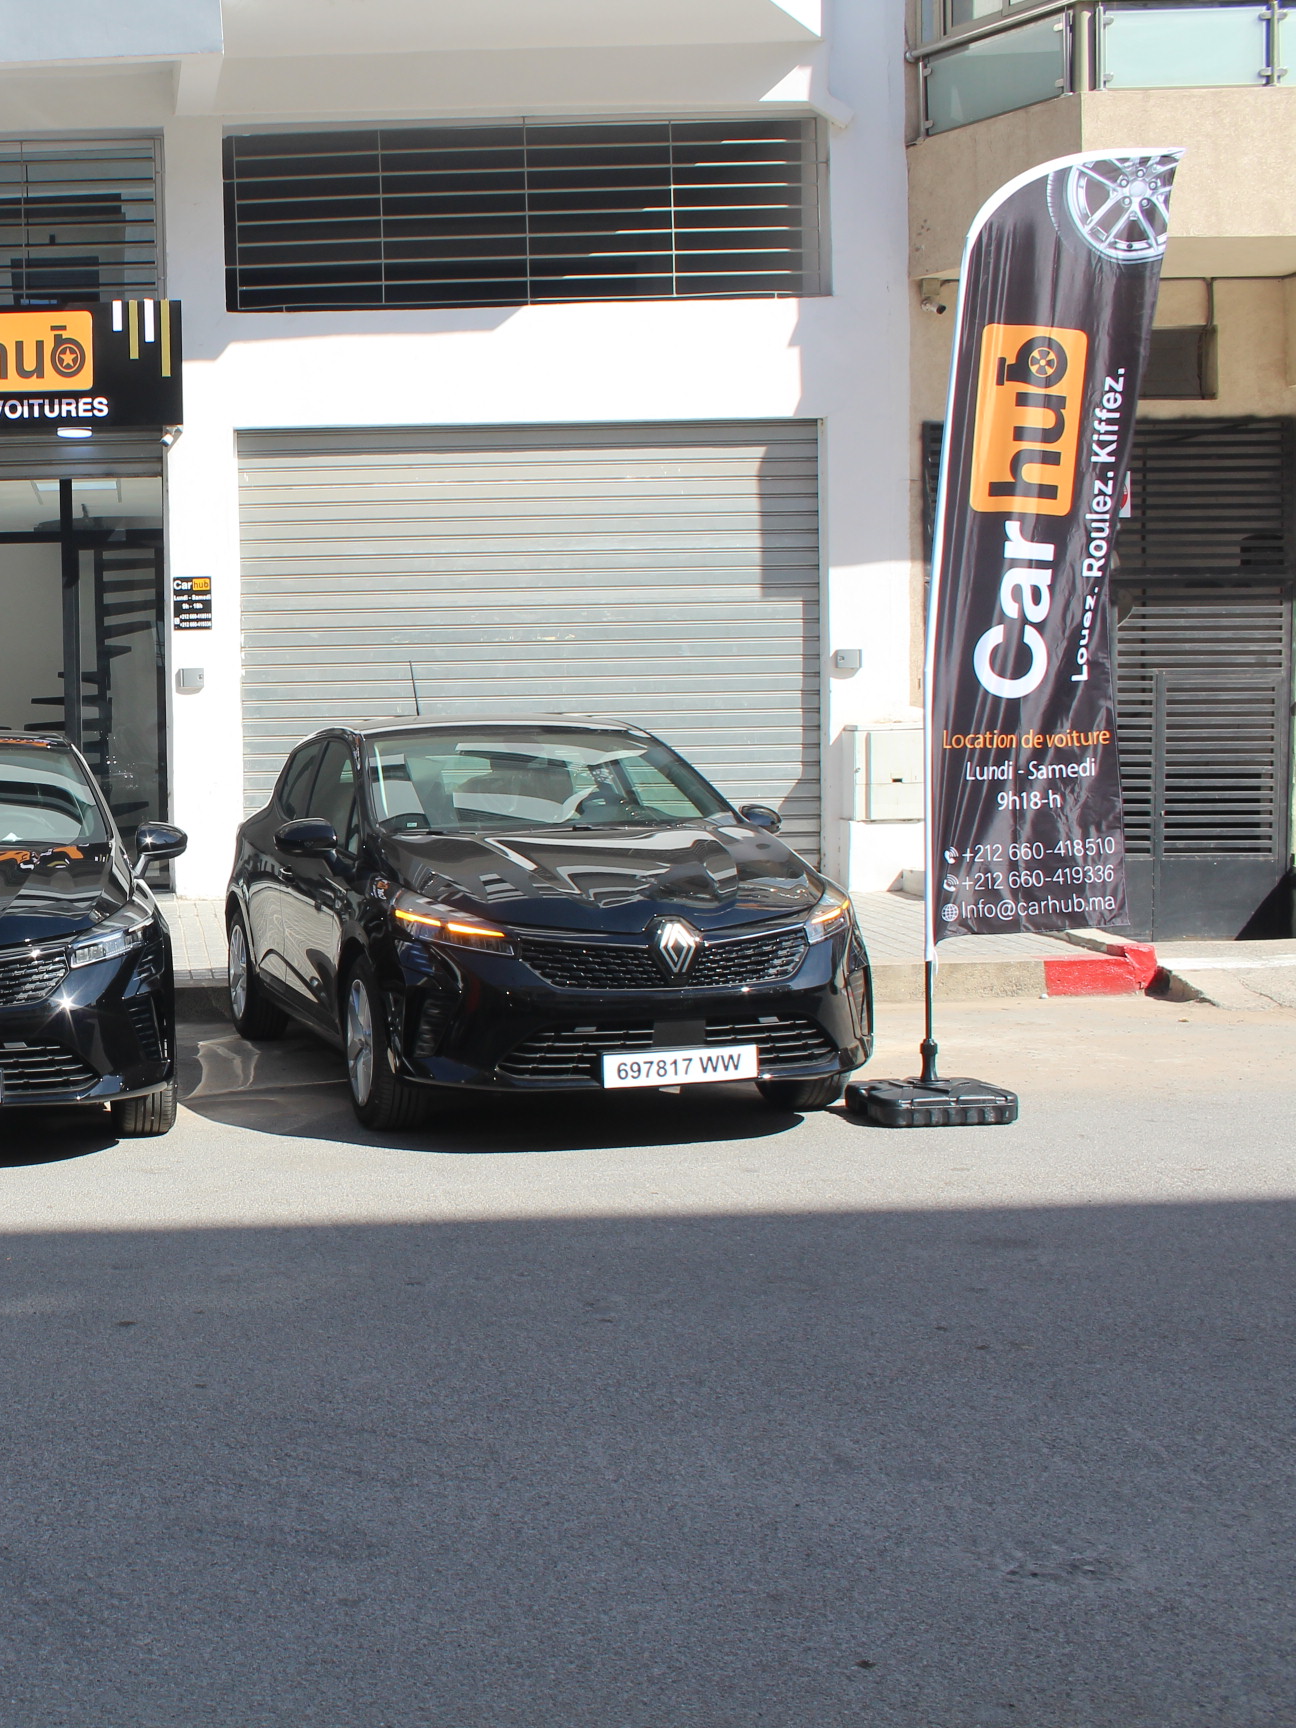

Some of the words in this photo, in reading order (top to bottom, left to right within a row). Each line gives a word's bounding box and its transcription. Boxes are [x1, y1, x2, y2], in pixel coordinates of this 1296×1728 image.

[988, 335, 1068, 500] hub
[1090, 367, 1125, 463] Kiffez.
[1082, 470, 1114, 577] Roulez.
[174, 580, 193, 590] Car
[194, 580, 209, 589] hub
[972, 521, 1056, 699] Car
[1071, 586, 1098, 682] Louez.
[943, 730, 1016, 749] Location
[1021, 729, 1043, 748] de
[1046, 729, 1110, 748] voiture
[966, 761, 1013, 780] Lundi
[1028, 757, 1096, 780] Samedi
[997, 790, 1061, 810] 9h18-h
[961, 844, 1003, 862] +212
[1009, 836, 1115, 861] 660-418510
[961, 871, 1003, 890] +212
[1008, 865, 1114, 888] 660-419336
[961, 893, 1116, 921] Info@carhub.ma
[616, 1058, 693, 1080] 697817
[699, 1053, 741, 1074] WW
